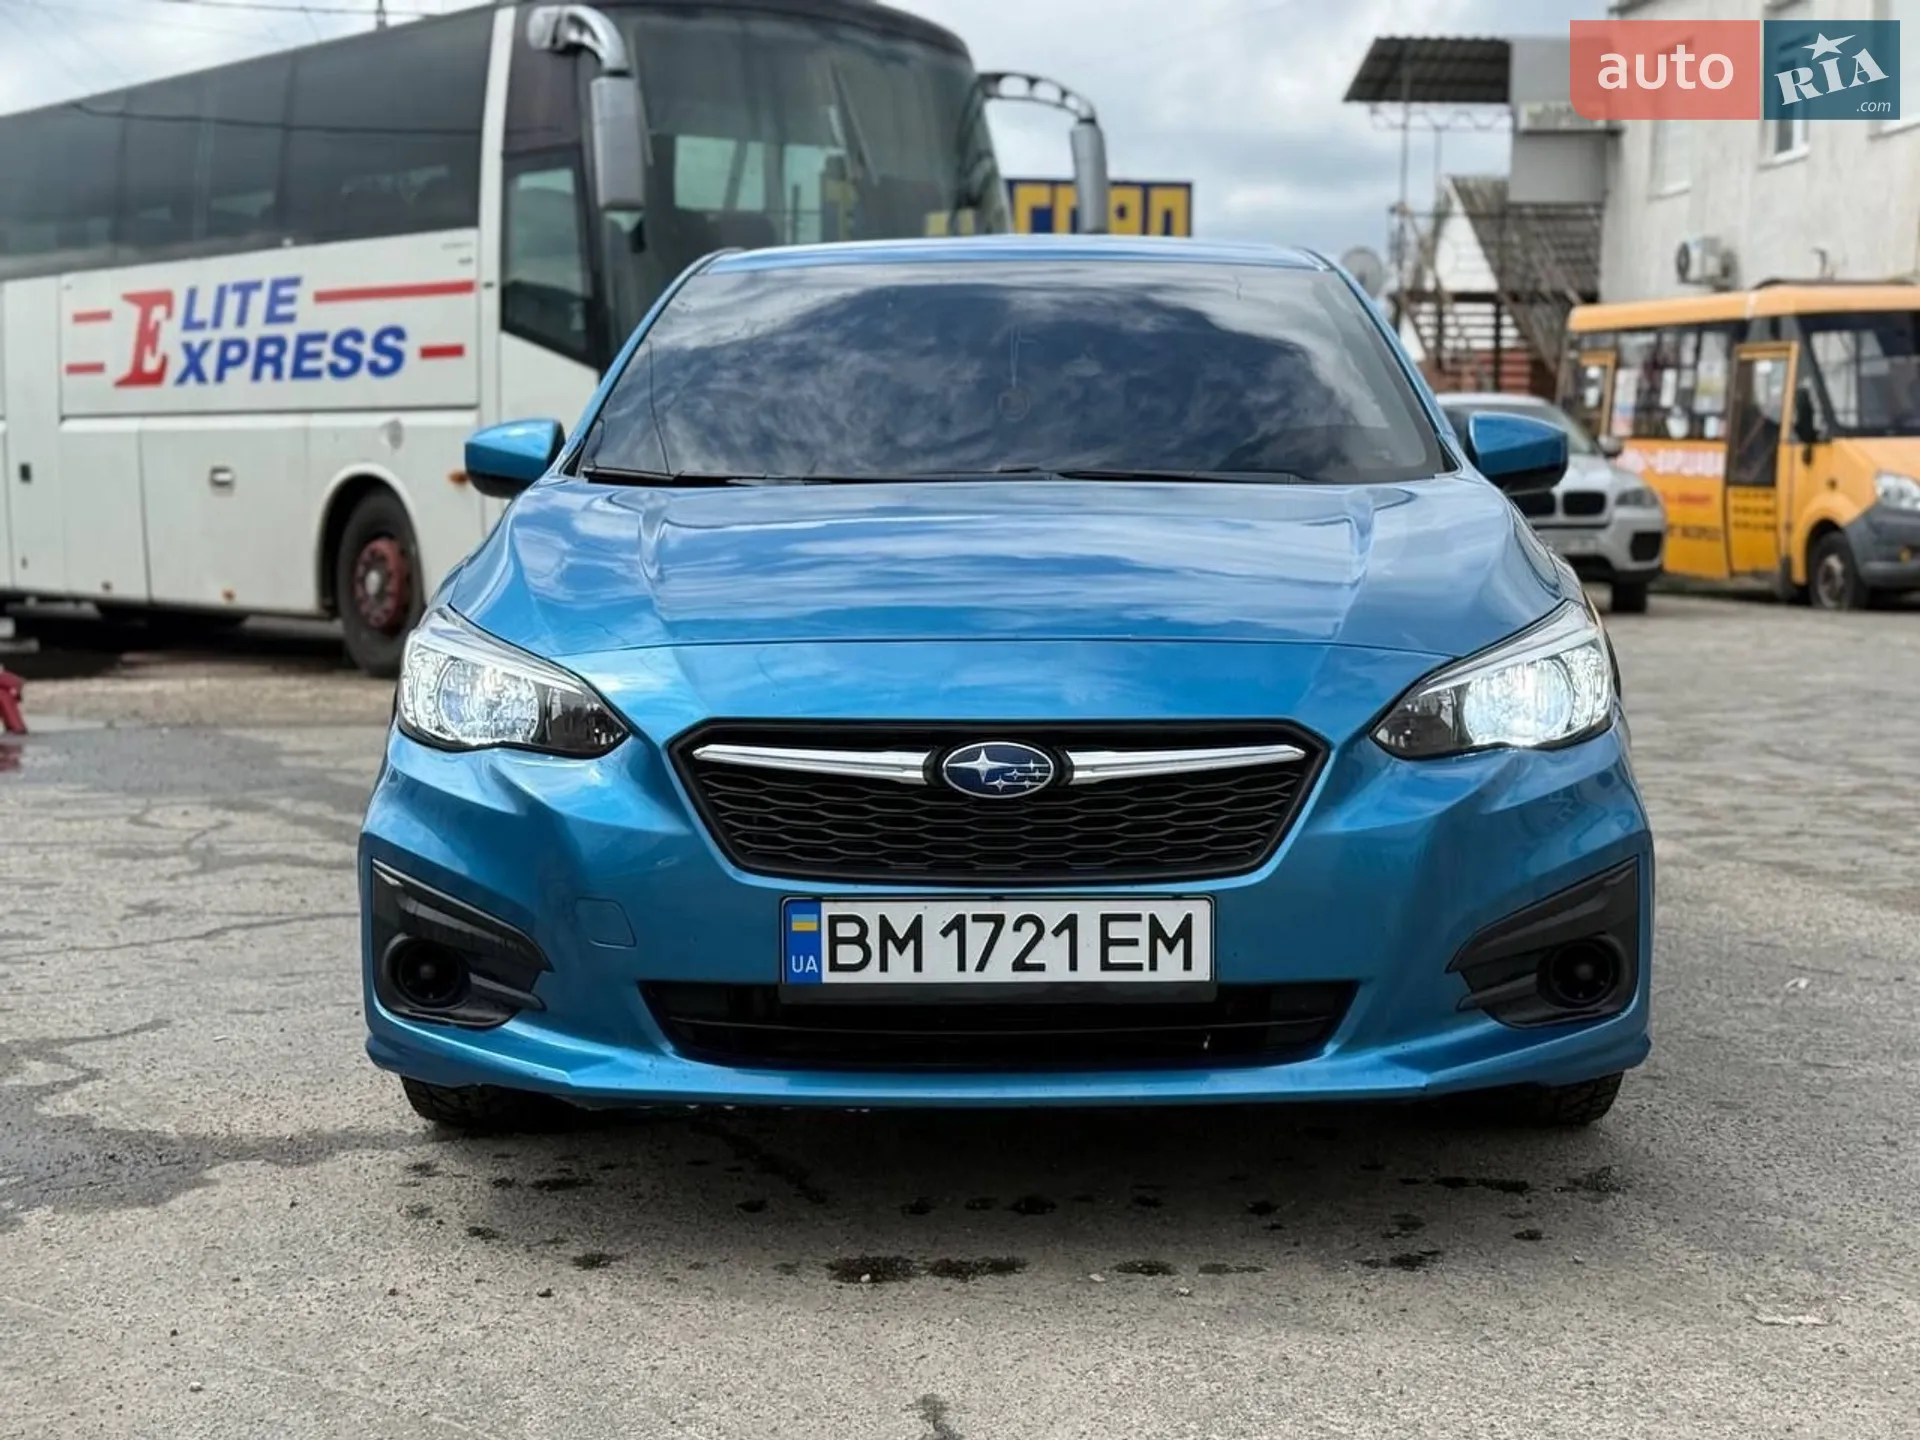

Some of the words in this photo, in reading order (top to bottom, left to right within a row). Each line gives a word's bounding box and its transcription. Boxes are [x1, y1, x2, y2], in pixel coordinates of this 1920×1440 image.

[827, 913, 923, 973] BM
[939, 913, 1079, 972] 1721
[1100, 912, 1193, 972] EM
[792, 955, 818, 973] UA
